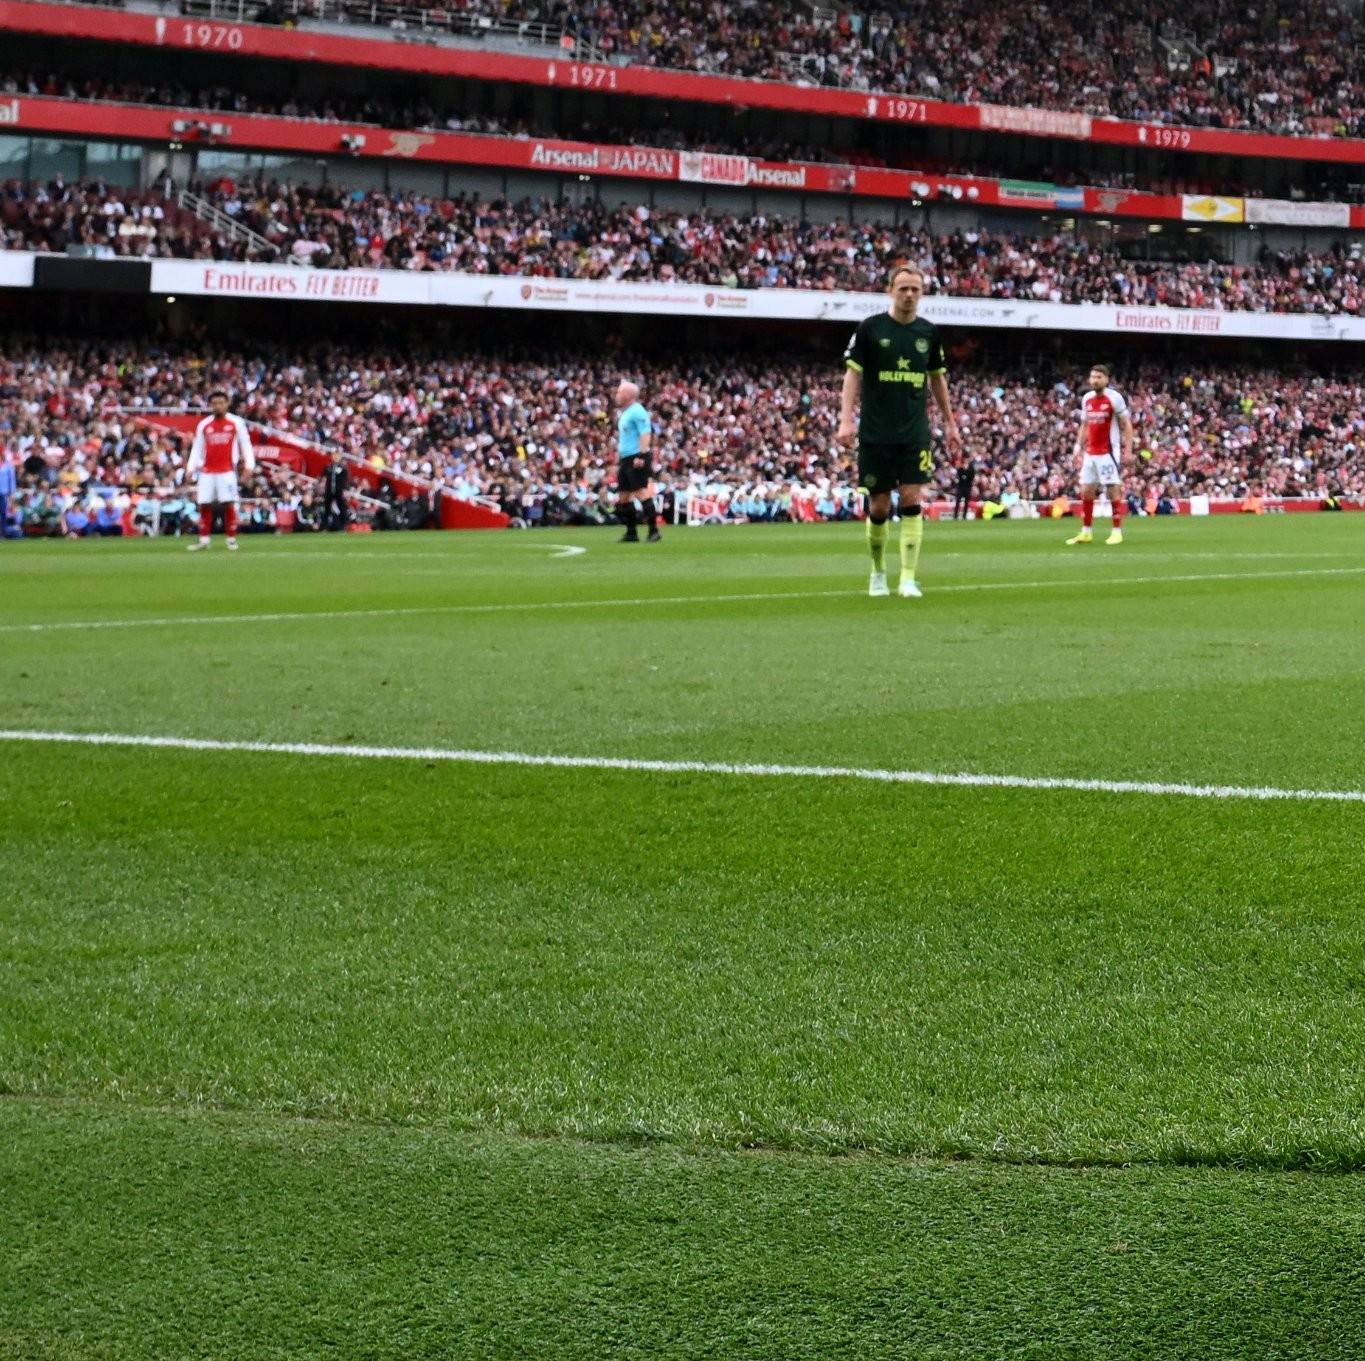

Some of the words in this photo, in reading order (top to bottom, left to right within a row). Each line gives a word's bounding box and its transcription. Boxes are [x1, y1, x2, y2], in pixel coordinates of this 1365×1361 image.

[182, 23, 244, 50] 1970
[569, 65, 617, 89] 1971
[887, 99, 927, 121] 1971
[1154, 128, 1190, 149] 1979
[531, 144, 598, 168] Arsenal
[611, 150, 674, 174] JAPAN
[748, 162, 806, 187] Arsenal
[203, 268, 298, 293] Emirates
[1115, 310, 1173, 330] Emirates
